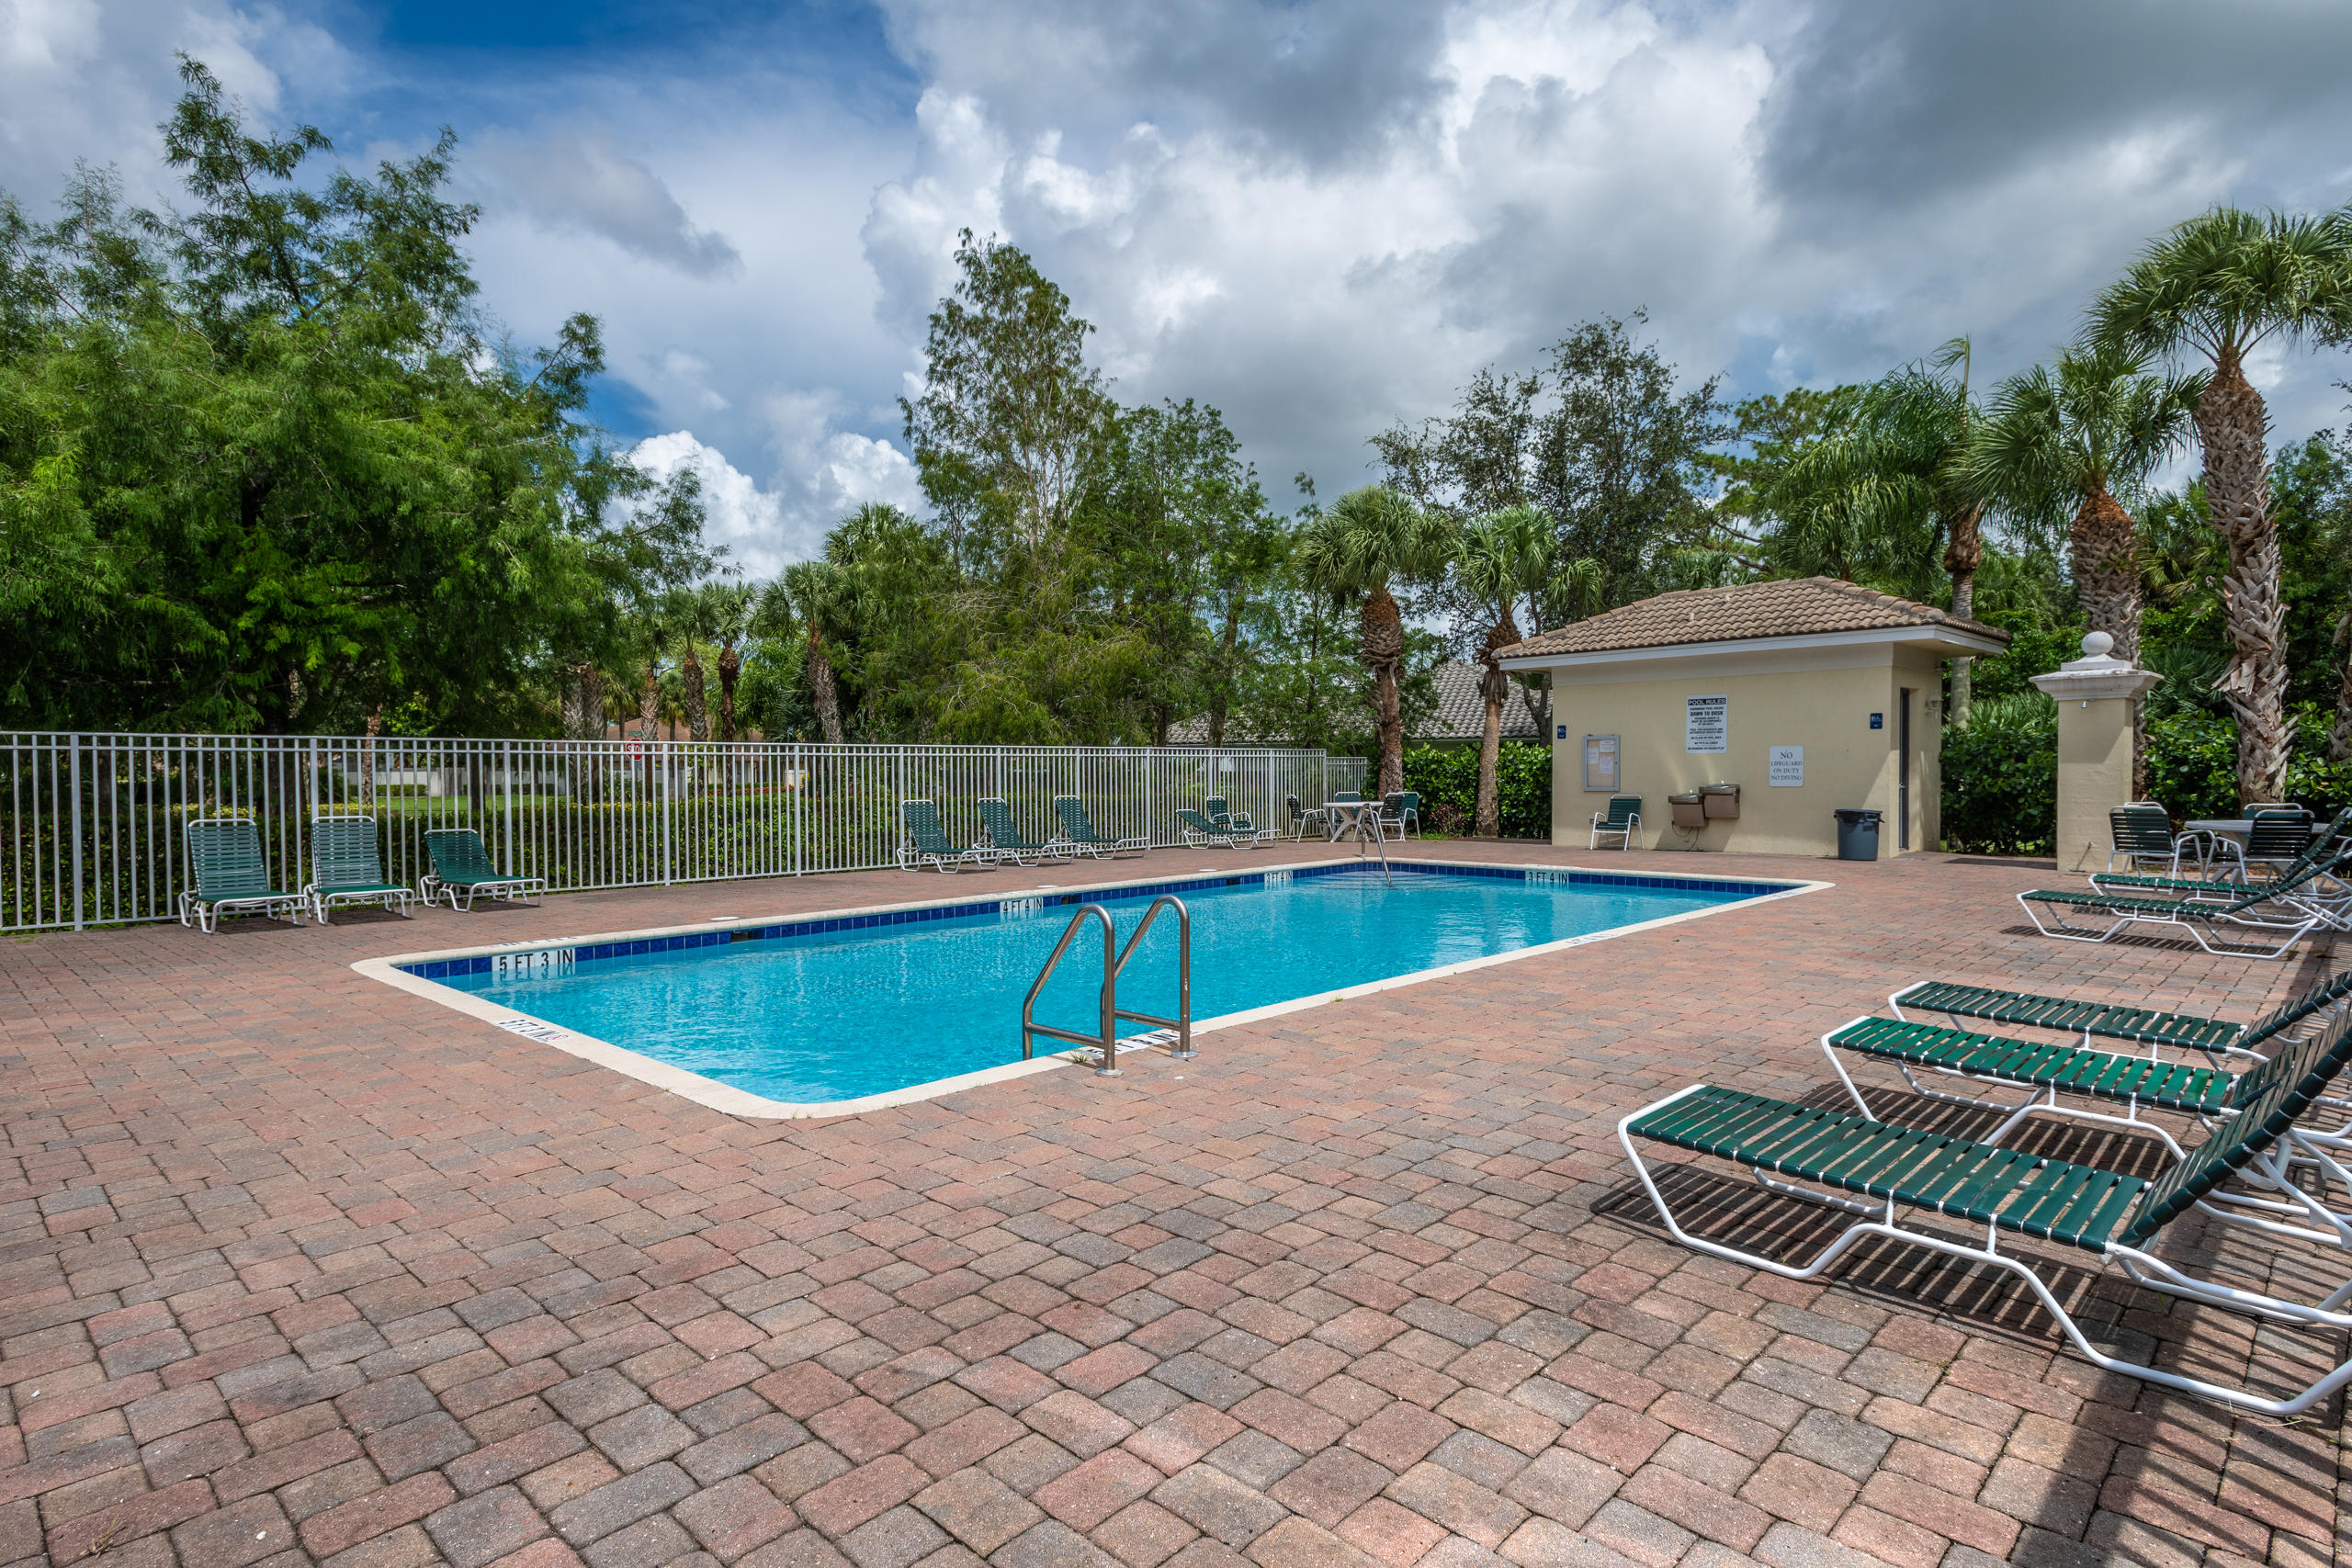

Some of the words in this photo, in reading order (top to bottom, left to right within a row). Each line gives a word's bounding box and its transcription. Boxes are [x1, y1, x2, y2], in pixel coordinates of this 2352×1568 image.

[1529, 872, 1533, 881] 3
[1536, 872, 1546, 883] FT
[1550, 873, 1555, 882] 4
[1558, 873, 1567, 883] IN
[1003, 901, 1008, 911] 4
[1012, 900, 1022, 911] FT
[1025, 899, 1030, 909] 4
[1034, 897, 1043, 908] IN
[499, 956, 507, 971] 5
[514, 953, 533, 969] FT
[541, 952, 548, 966] 3
[557, 948, 573, 964] IN
